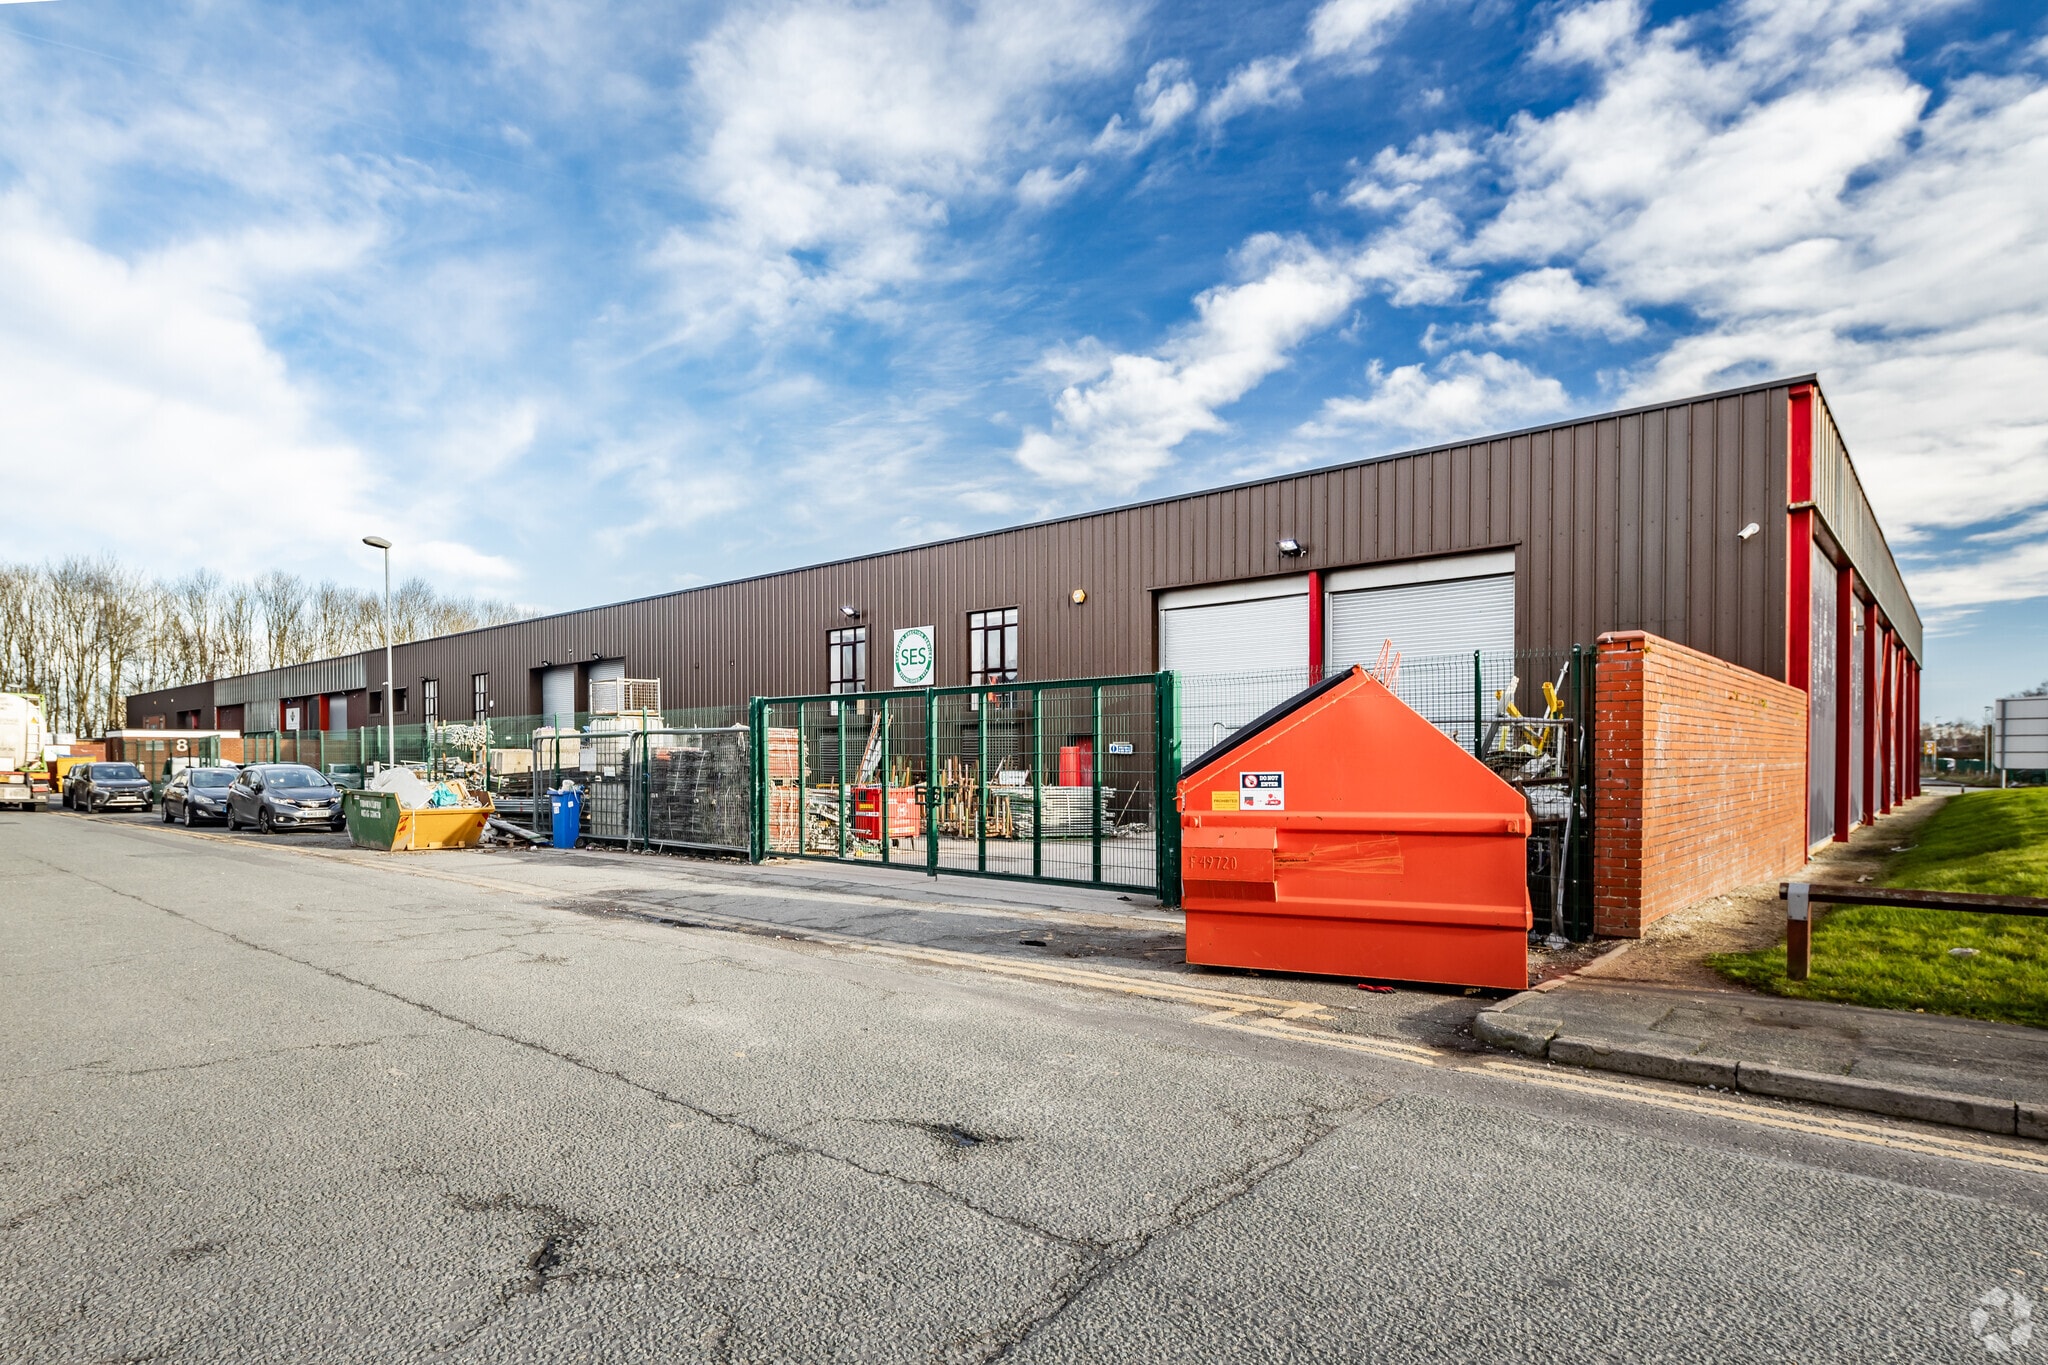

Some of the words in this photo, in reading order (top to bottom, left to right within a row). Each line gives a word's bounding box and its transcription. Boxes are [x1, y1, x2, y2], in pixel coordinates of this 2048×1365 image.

[901, 647, 926, 666] SES
[176, 738, 188, 752] 8
[1199, 855, 1238, 870] 49720
